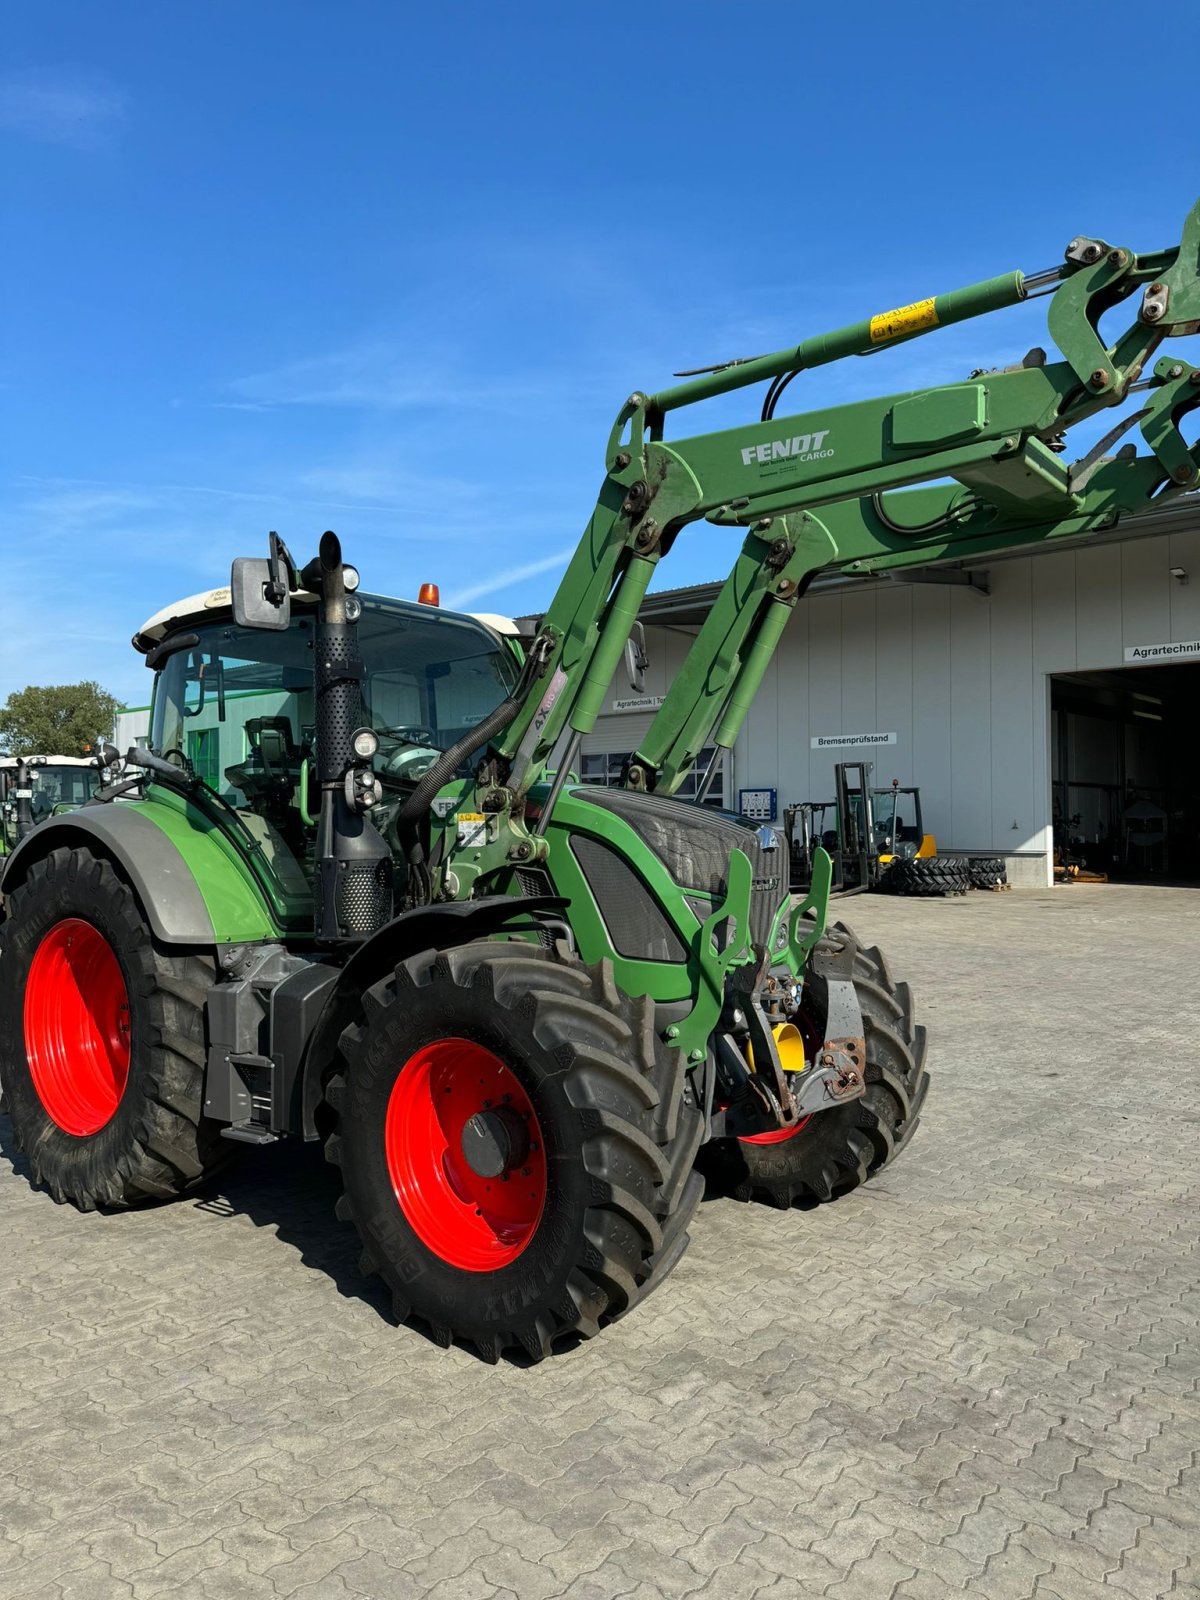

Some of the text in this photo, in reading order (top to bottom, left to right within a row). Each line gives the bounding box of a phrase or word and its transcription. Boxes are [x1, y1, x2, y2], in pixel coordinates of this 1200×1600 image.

[741, 430, 830, 465] FENDT
[800, 448, 835, 462] CARGO
[617, 698, 652, 708] Agrartechnik
[818, 734, 889, 745] Bremsenprüfstand
[368, 1213, 425, 1283] BKT
